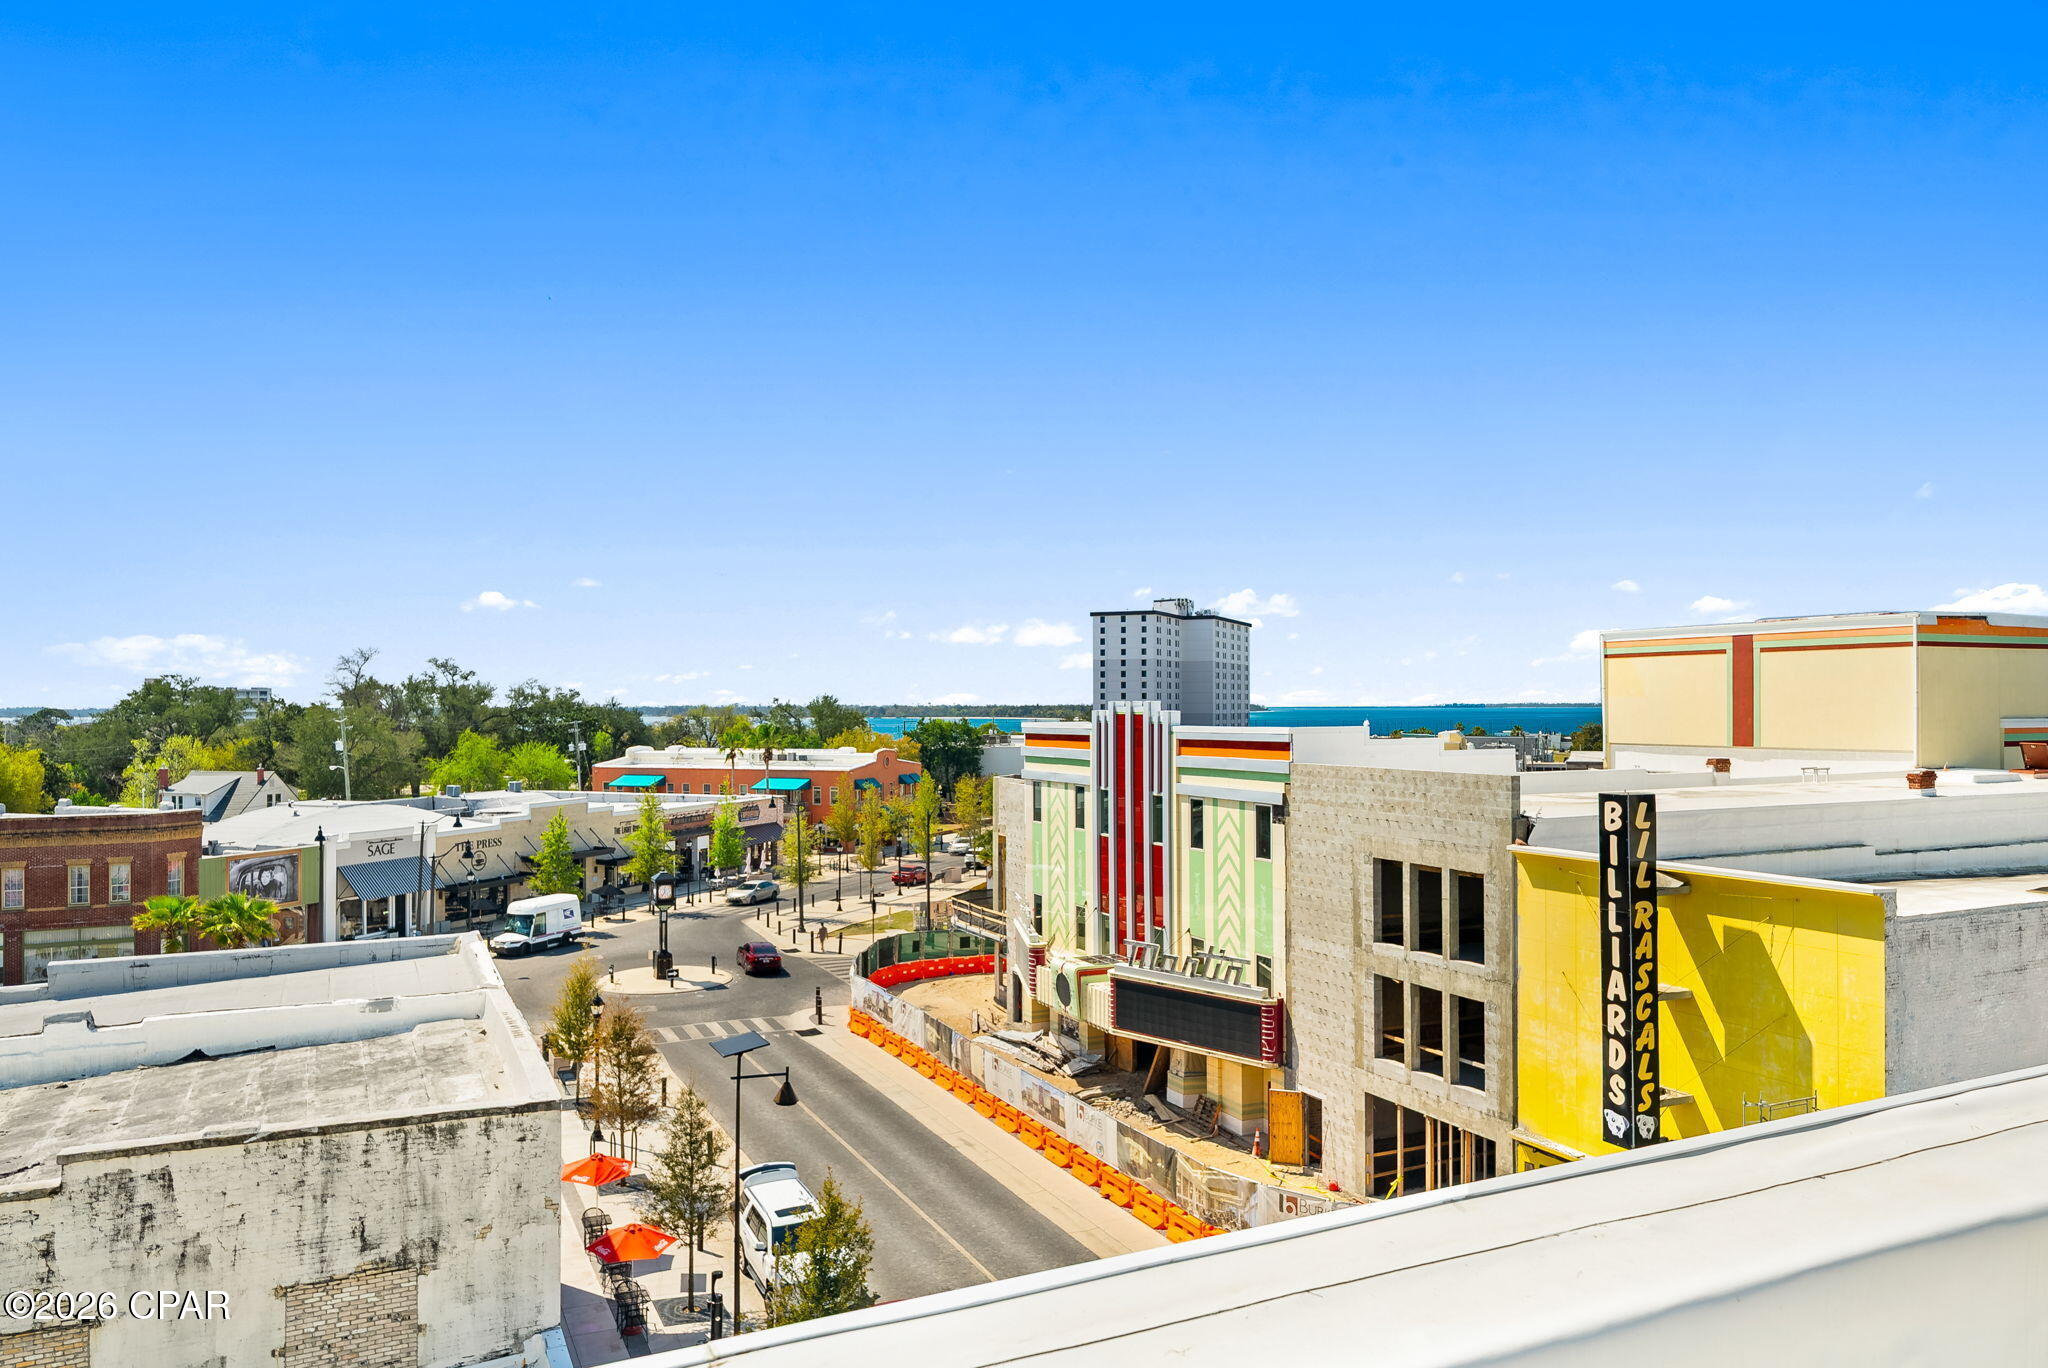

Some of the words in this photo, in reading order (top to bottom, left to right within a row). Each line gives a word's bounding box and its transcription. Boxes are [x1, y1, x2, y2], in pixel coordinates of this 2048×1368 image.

[367, 842, 395, 857] SAGE
[476, 837, 502, 849] PRESS
[1634, 801, 1652, 889] LIL
[1603, 800, 1628, 1107] BILLIARDS
[1633, 900, 1655, 1113] RASCALS
[1299, 1198, 1335, 1215] BUR
